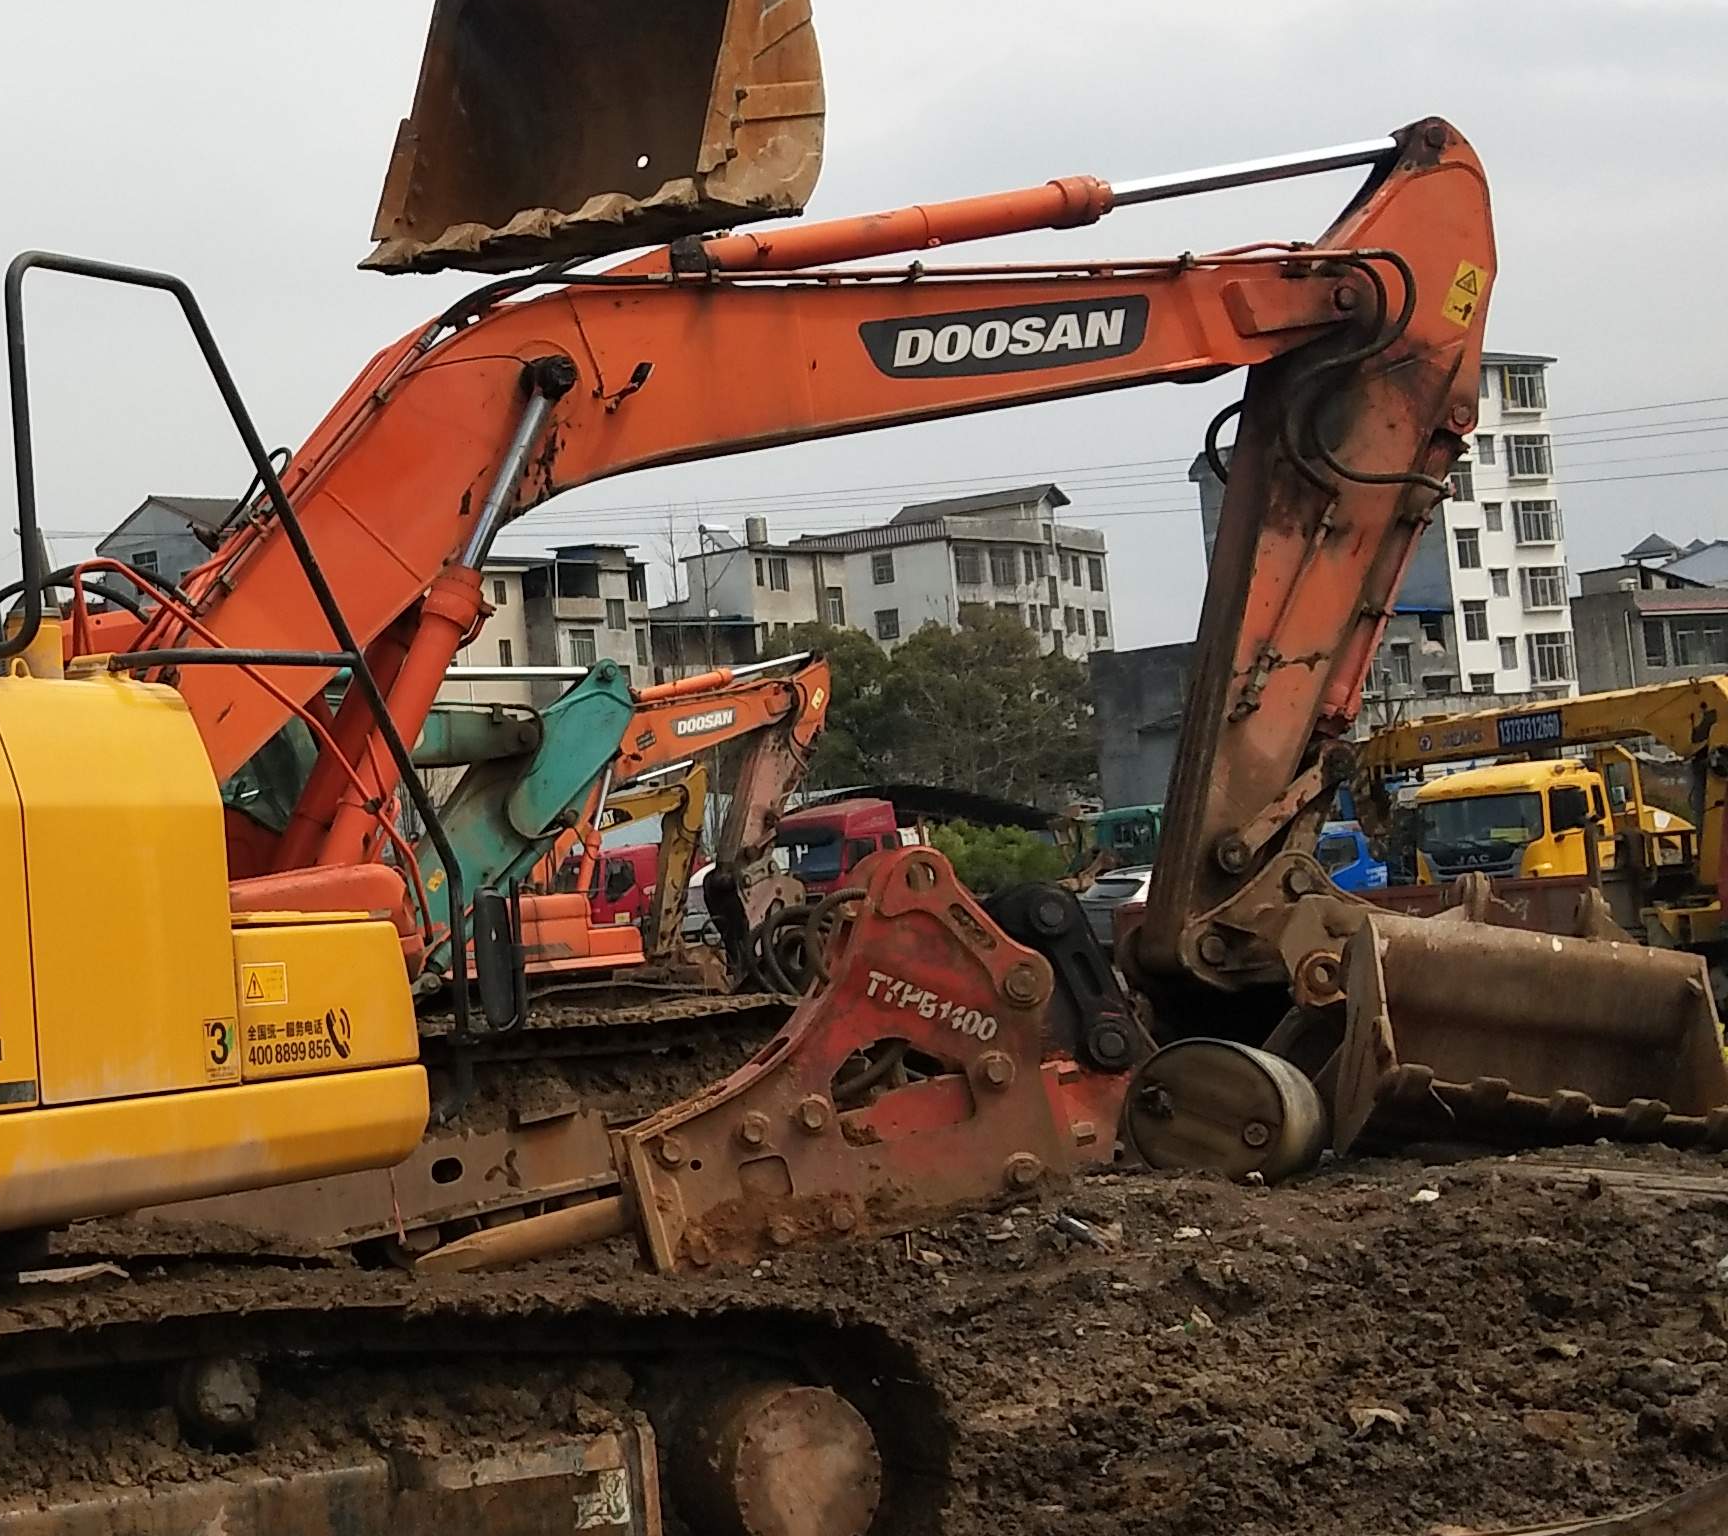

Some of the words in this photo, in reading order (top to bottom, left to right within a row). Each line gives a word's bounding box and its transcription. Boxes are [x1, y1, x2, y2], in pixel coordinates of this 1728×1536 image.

[893, 309, 1126, 368] DOOSAN
[677, 710, 734, 735] DOOSAN
[1458, 854, 1490, 866] JAC
[247, 1019, 323, 1041] 全国统一服务电话
[248, 1045, 273, 1065] 400
[275, 1041, 306, 1063] 8899
[308, 1039, 332, 1059] 856
